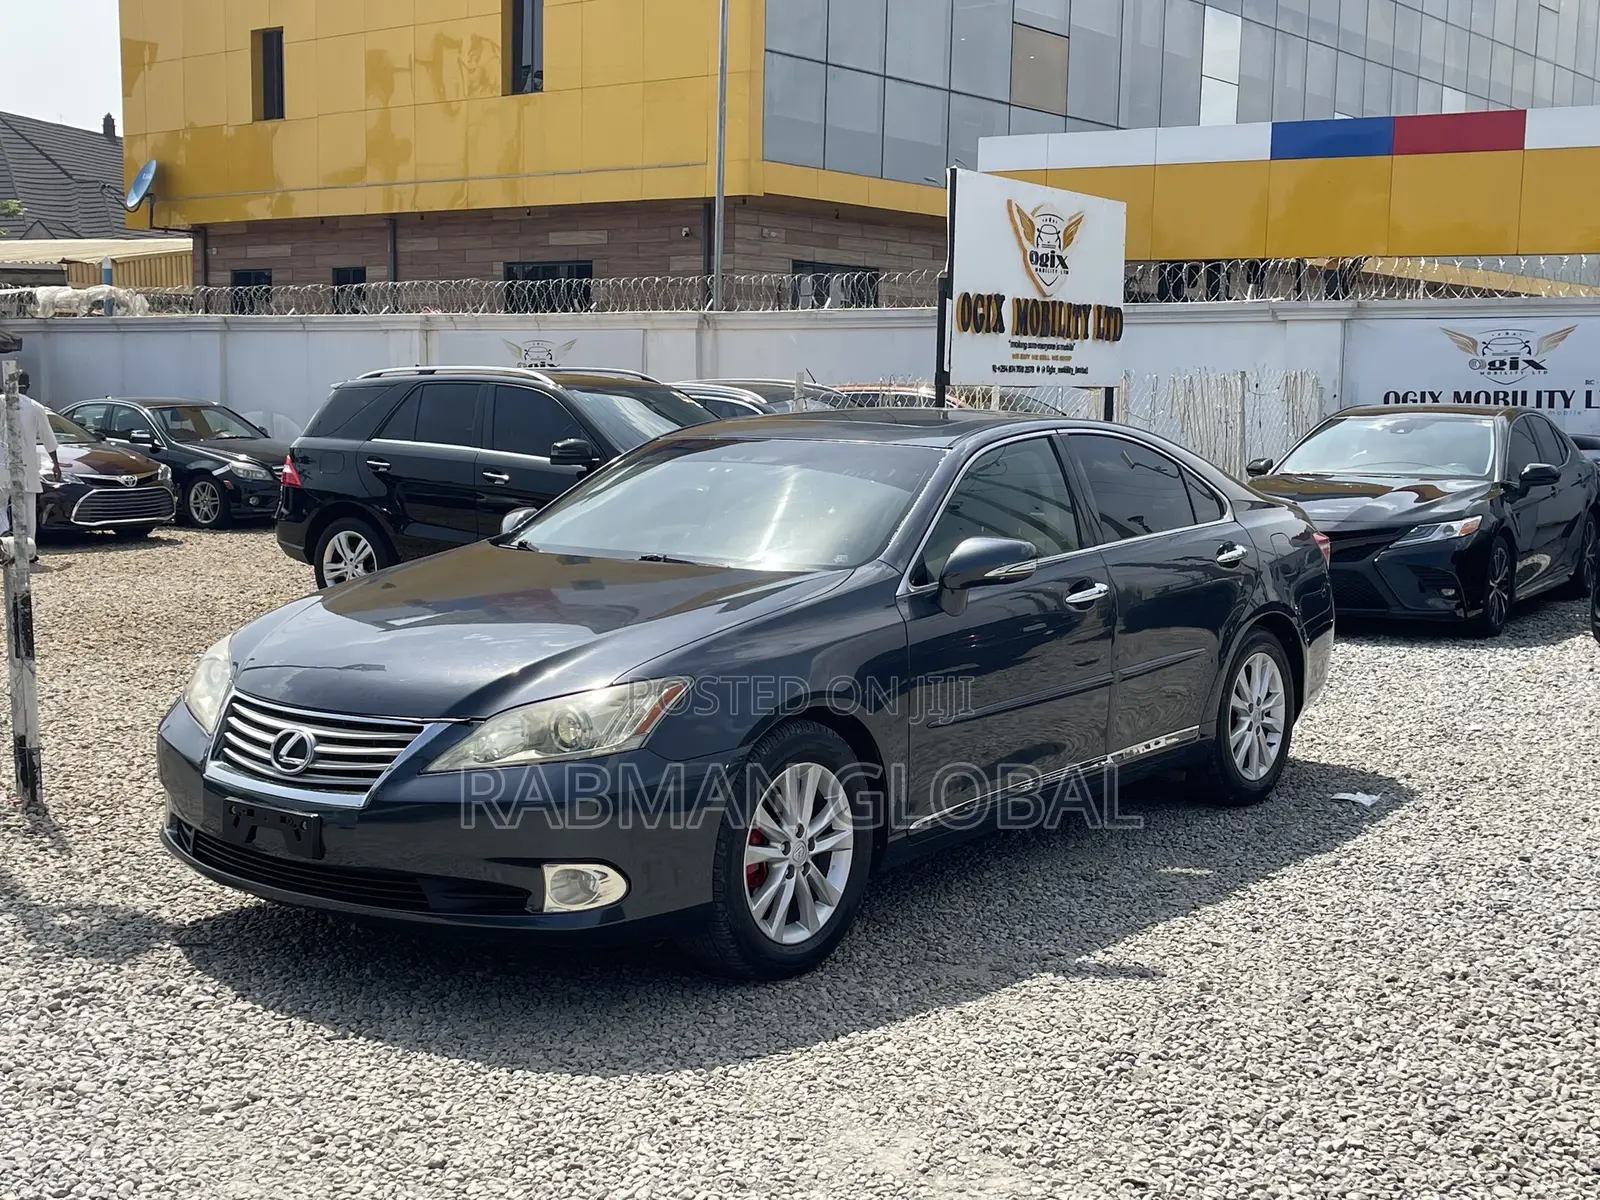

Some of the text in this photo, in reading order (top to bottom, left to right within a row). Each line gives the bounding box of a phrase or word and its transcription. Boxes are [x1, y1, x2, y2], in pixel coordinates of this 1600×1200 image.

[1029, 250, 1069, 270] Ogix
[957, 292, 1124, 342] OGIX MOBILITY LTD
[1469, 357, 1548, 371] Ogix
[1383, 390, 1443, 405] OGIX
[1453, 390, 1576, 409] MOBILITY
